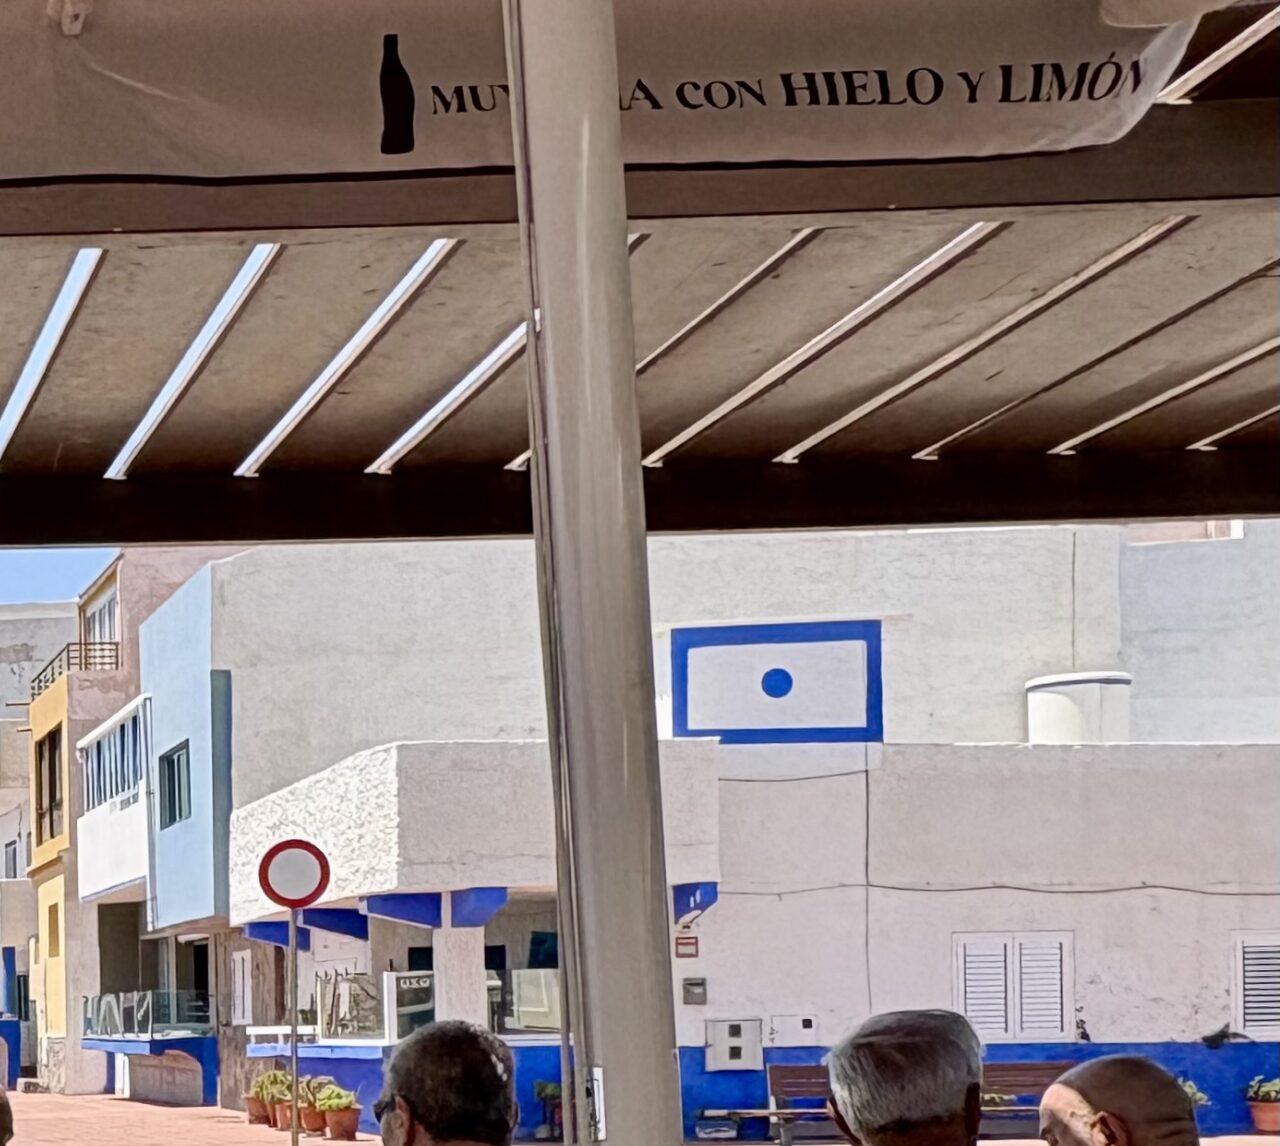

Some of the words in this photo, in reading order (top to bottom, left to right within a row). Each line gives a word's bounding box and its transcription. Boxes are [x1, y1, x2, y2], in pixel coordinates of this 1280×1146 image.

[675, 78, 767, 110] CON
[779, 67, 944, 107] HIELO
[957, 71, 985, 103] Y
